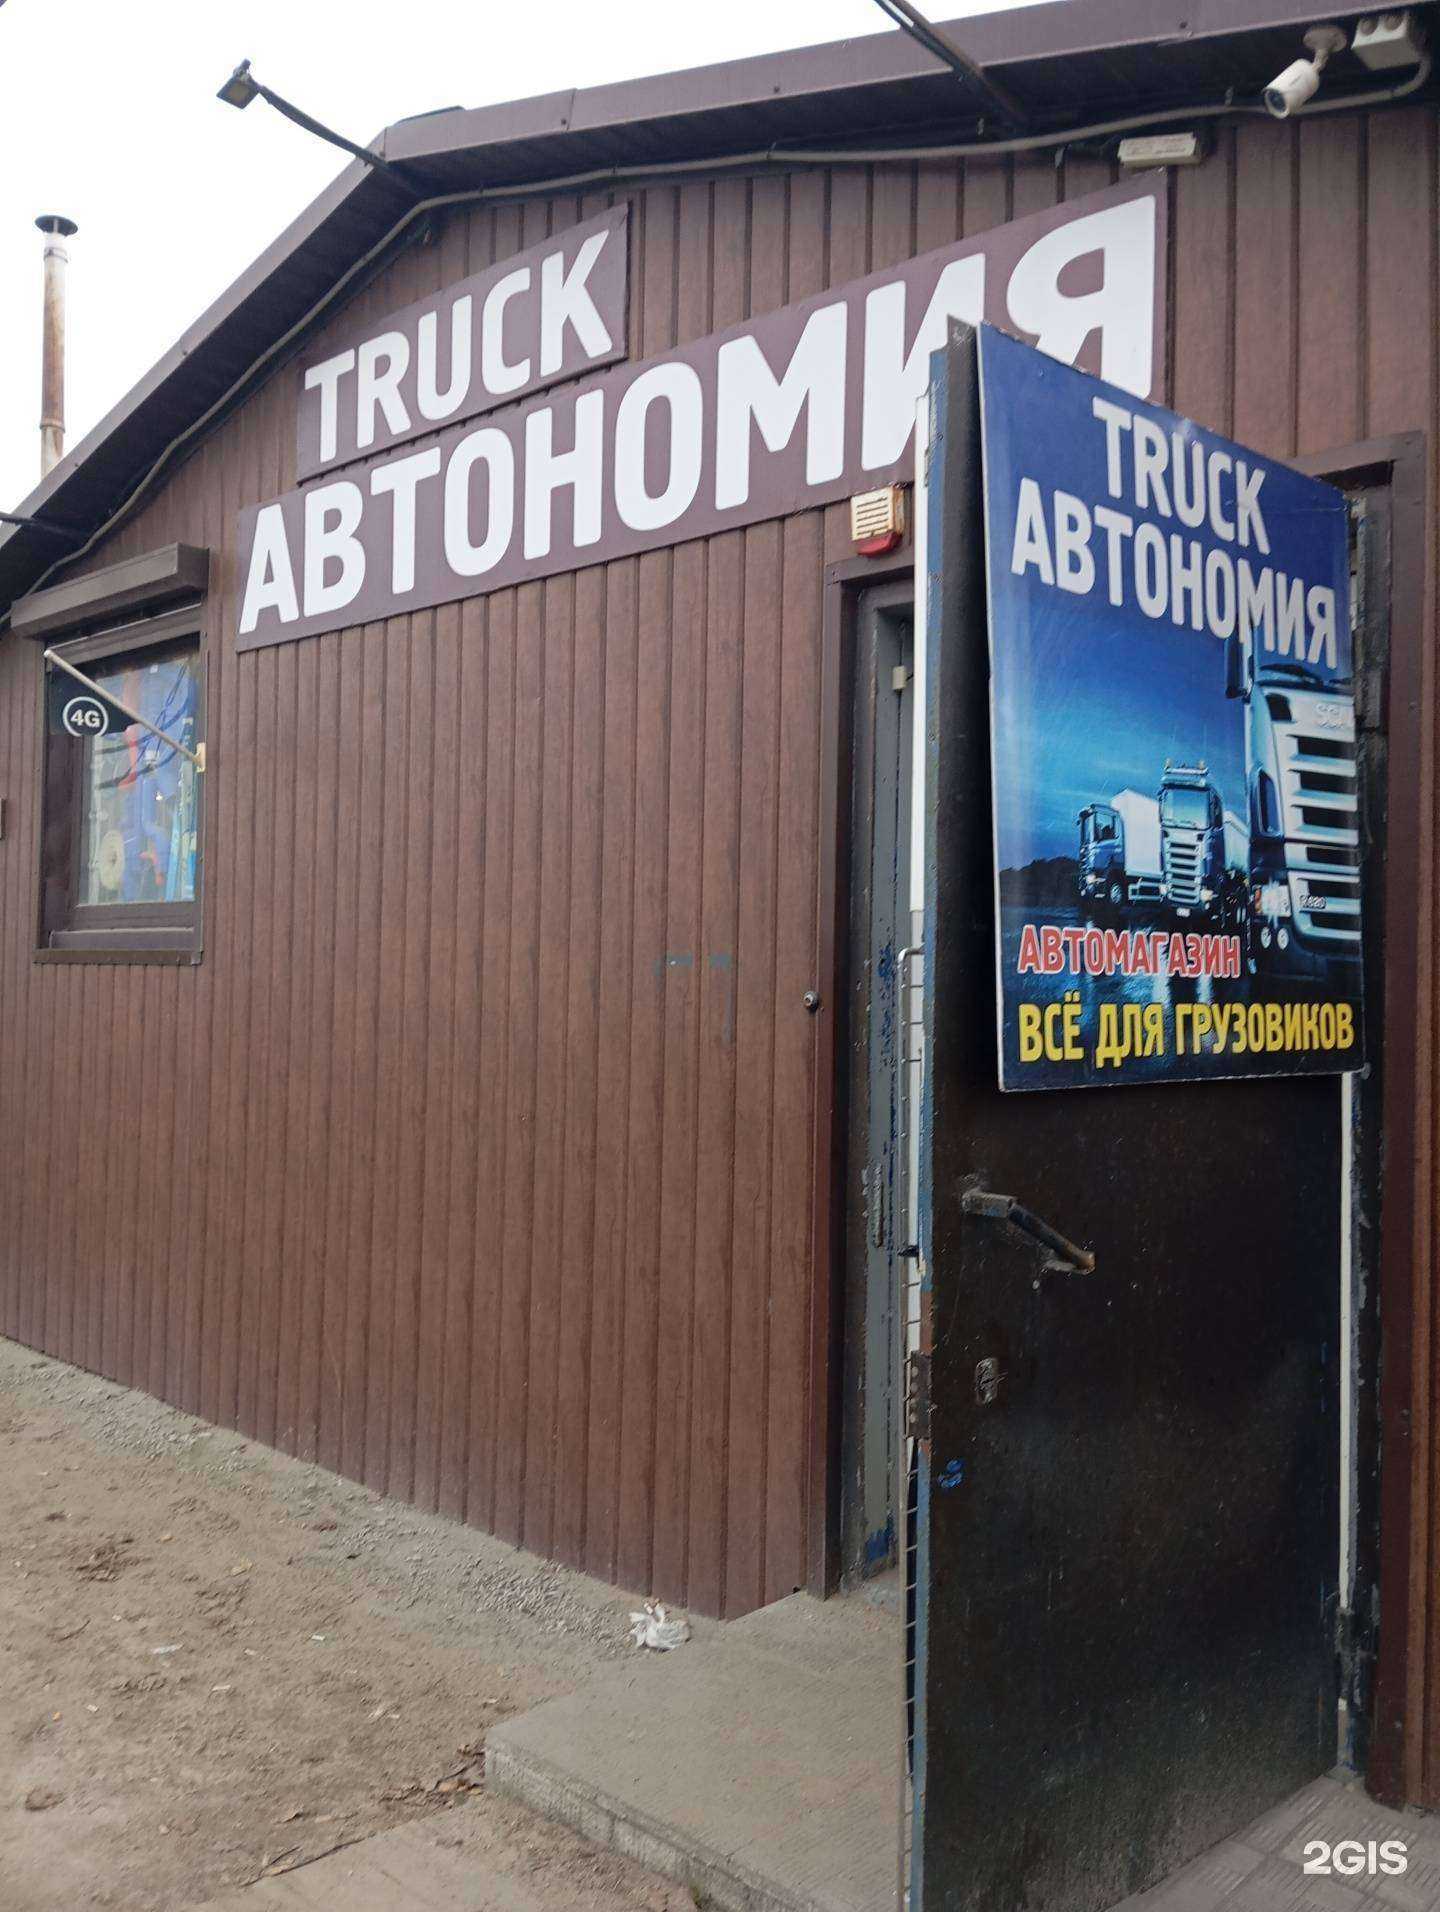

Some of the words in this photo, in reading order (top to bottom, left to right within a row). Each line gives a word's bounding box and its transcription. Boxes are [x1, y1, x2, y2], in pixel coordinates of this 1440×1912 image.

[239, 195, 1156, 634] АВТОНОМИЯ
[304, 229, 612, 464] TRUCK
[1092, 396, 1271, 555] TRUCK
[1010, 477, 1337, 670] АВТОНОМИЯ
[70, 709, 100, 728] 4G
[1016, 925, 1242, 979] АВТОМАГАЗИН
[1018, 990, 1084, 1063] ВСЁ
[1094, 1003, 1165, 1069] ДЛЯ
[1175, 1002, 1355, 1056] ГРУЗОВИКОВ
